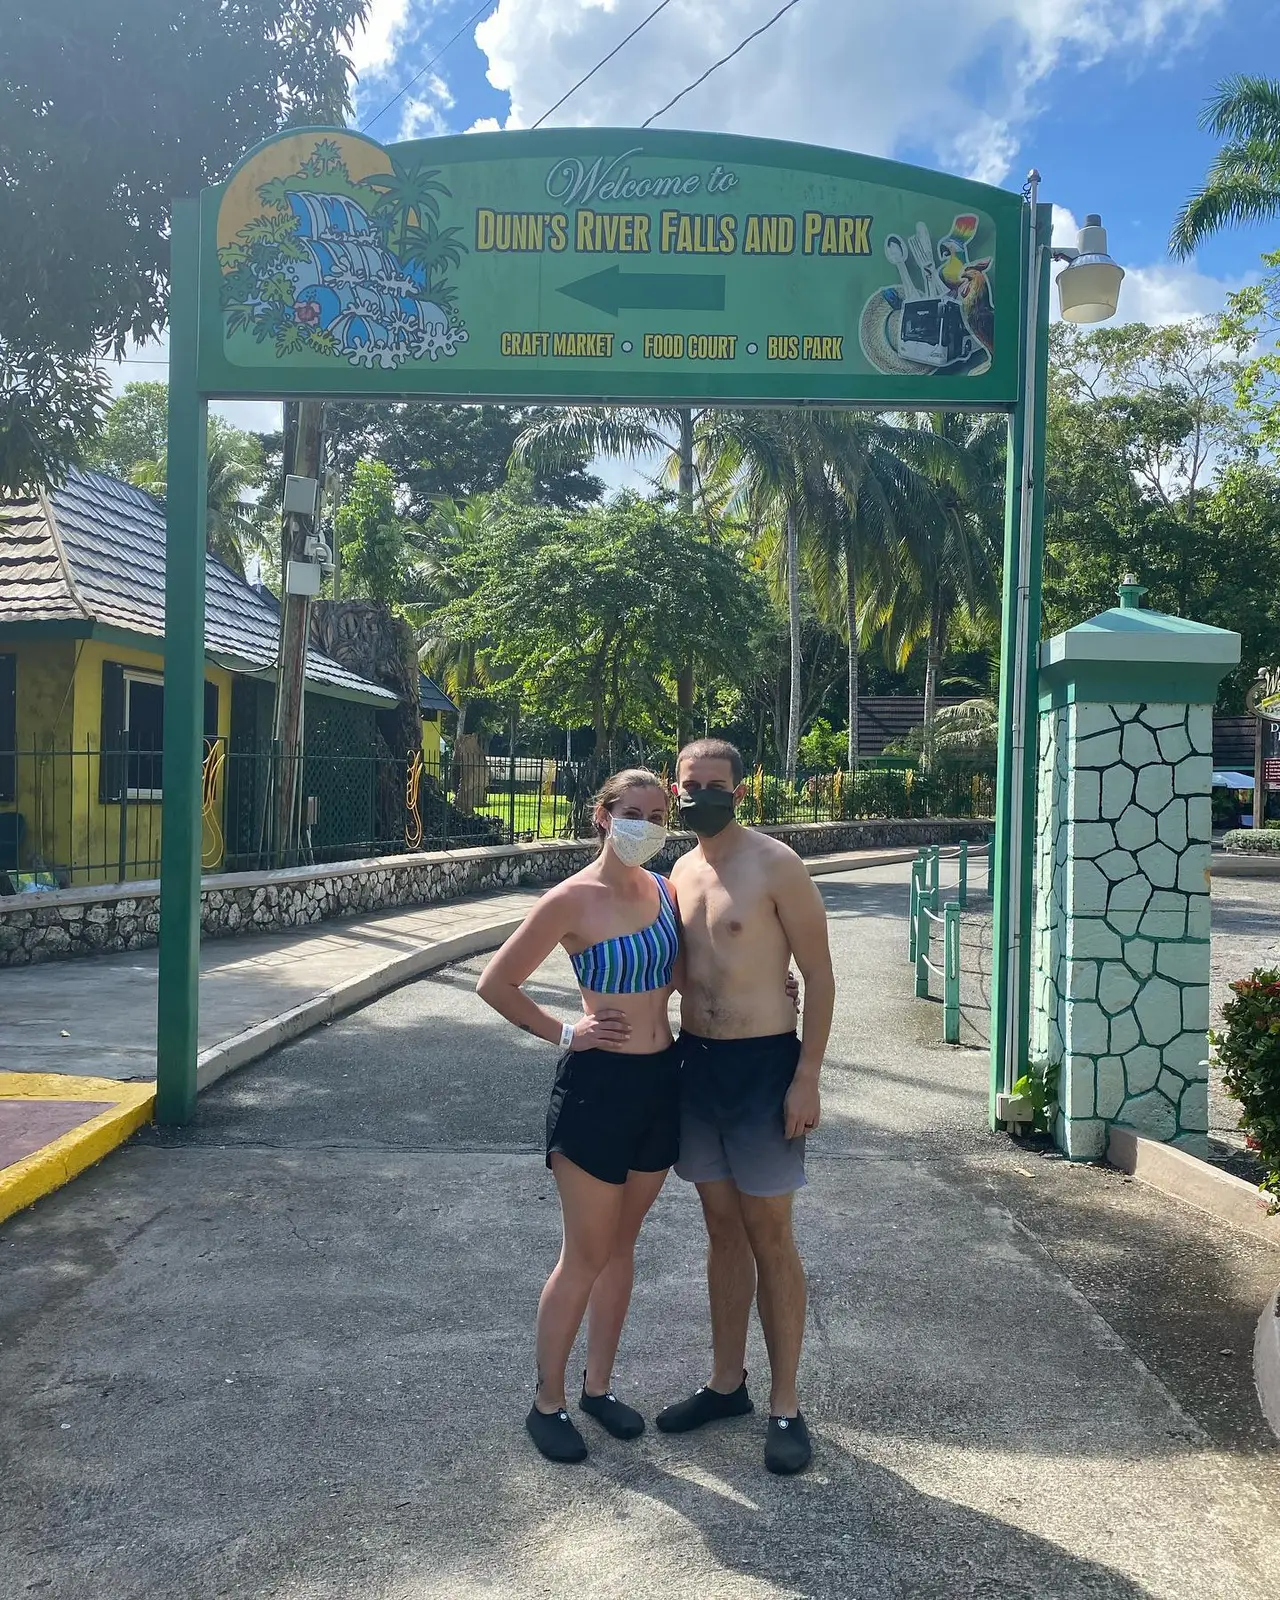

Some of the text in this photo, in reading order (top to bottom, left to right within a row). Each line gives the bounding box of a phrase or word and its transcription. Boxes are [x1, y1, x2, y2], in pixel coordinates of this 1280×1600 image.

[545, 147, 738, 205] Welcome to
[477, 209, 871, 254] DUNN'S RIVER FALLS AND PARK
[501, 332, 614, 356] CRAFT MARKET
[644, 334, 738, 359] FOOD COURT
[767, 336, 843, 360] BUS PARK
